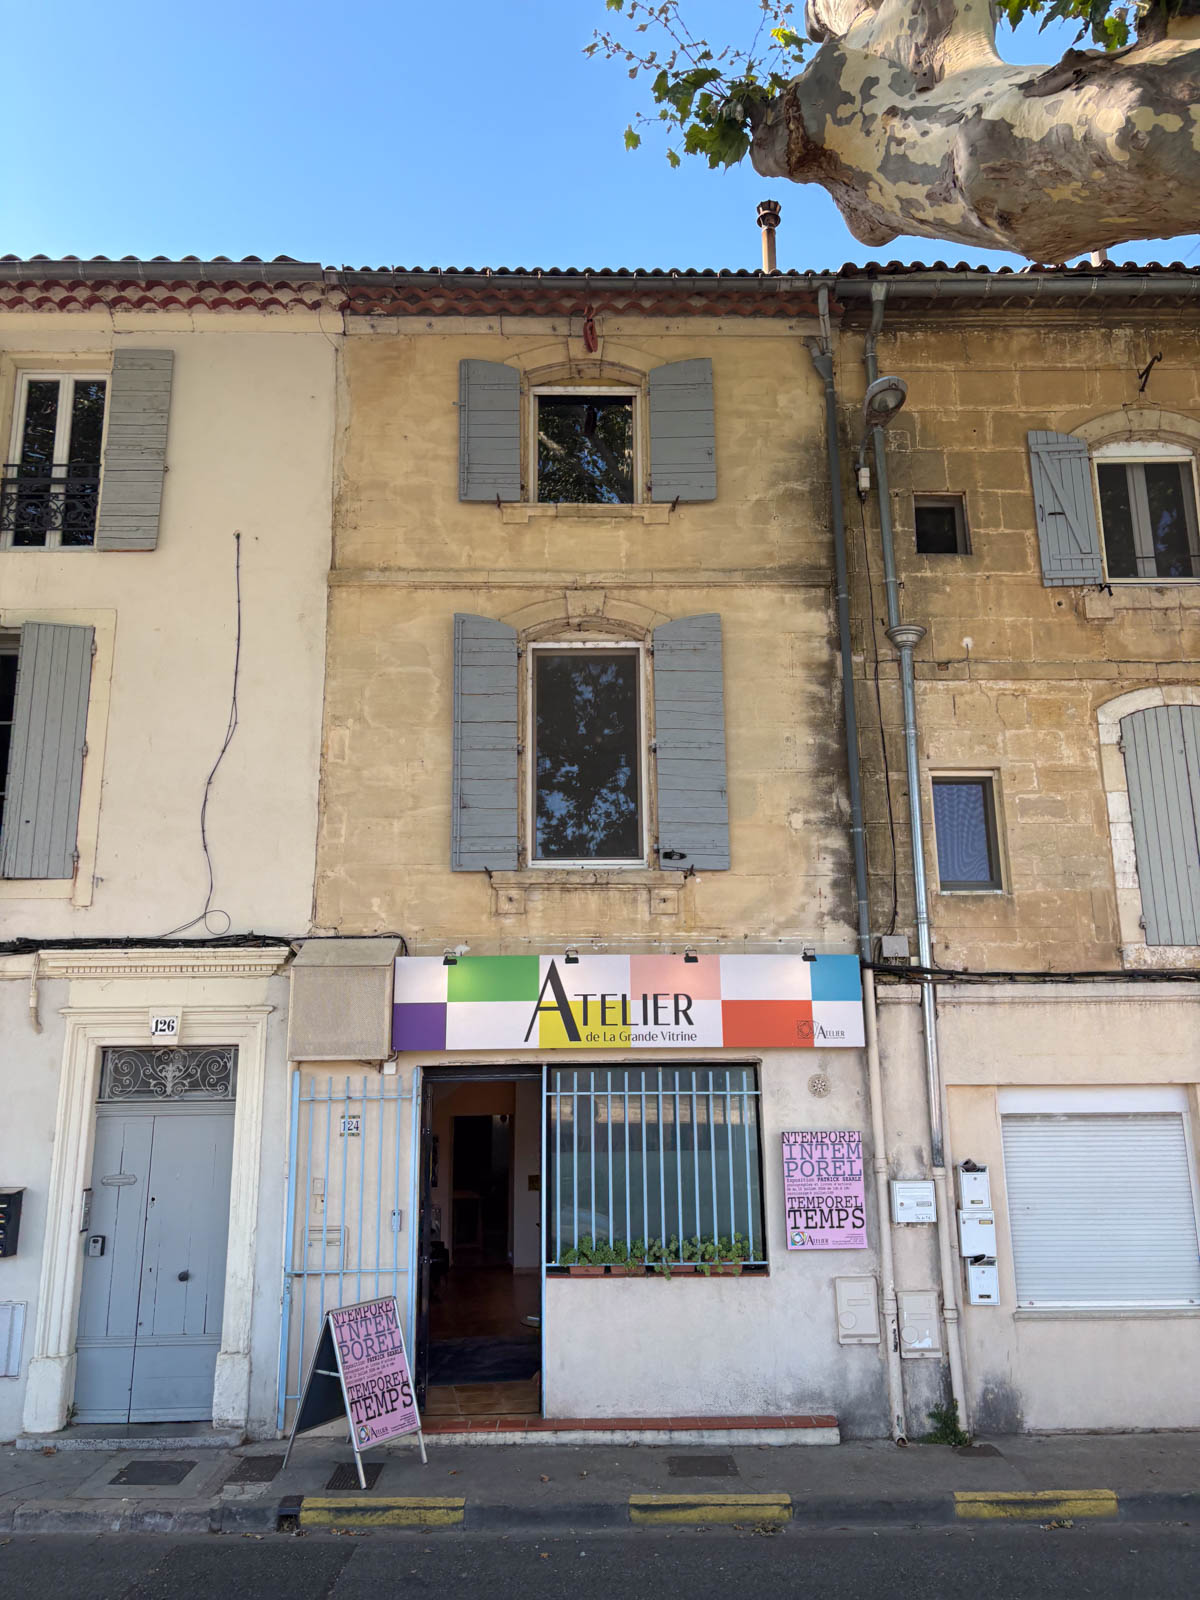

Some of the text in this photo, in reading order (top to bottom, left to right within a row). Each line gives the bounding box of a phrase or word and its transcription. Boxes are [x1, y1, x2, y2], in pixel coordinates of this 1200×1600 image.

[523, 958, 695, 1042] ATELIER
[154, 1019, 175, 1032] 126
[585, 1031, 697, 1042] de La Grande Vitrine
[342, 1120, 359, 1131] 124
[785, 1143, 862, 1160] INTEM
[784, 1160, 862, 1177] POREL
[788, 1195, 862, 1209] TEMPOREL
[788, 1208, 865, 1229] TEMPS
[336, 1312, 400, 1344] INTEM
[339, 1330, 403, 1364] POREL
[367, 1353, 386, 1363] PATRICK
[347, 1370, 409, 1401] TEMPOREL
[350, 1383, 414, 1425] TEMPS
